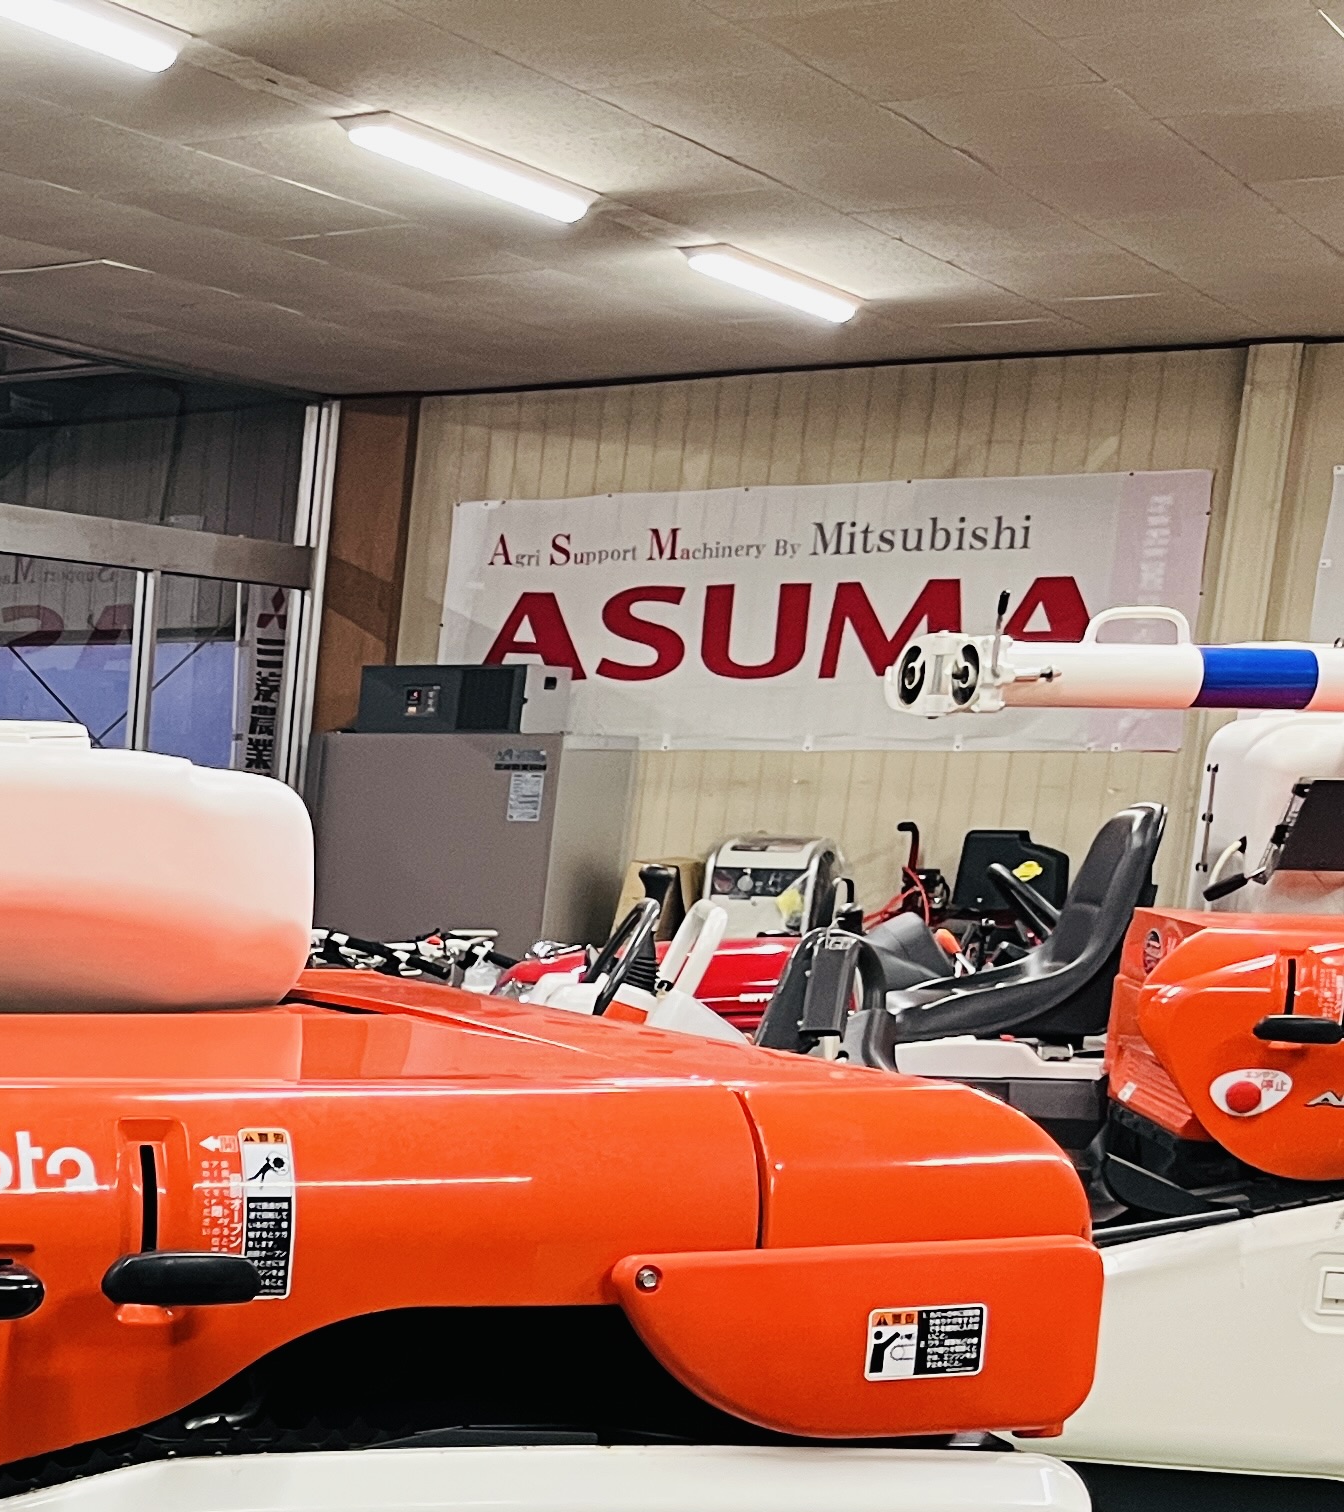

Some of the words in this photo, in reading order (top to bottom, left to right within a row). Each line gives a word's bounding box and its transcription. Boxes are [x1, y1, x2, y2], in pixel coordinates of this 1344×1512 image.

[487, 533, 541, 568] Agri
[549, 533, 637, 567] Support
[646, 527, 764, 562] Machinery
[774, 538, 801, 560] By
[809, 514, 1032, 557] Mitsubishi
[481, 575, 1093, 682] ASUMA
